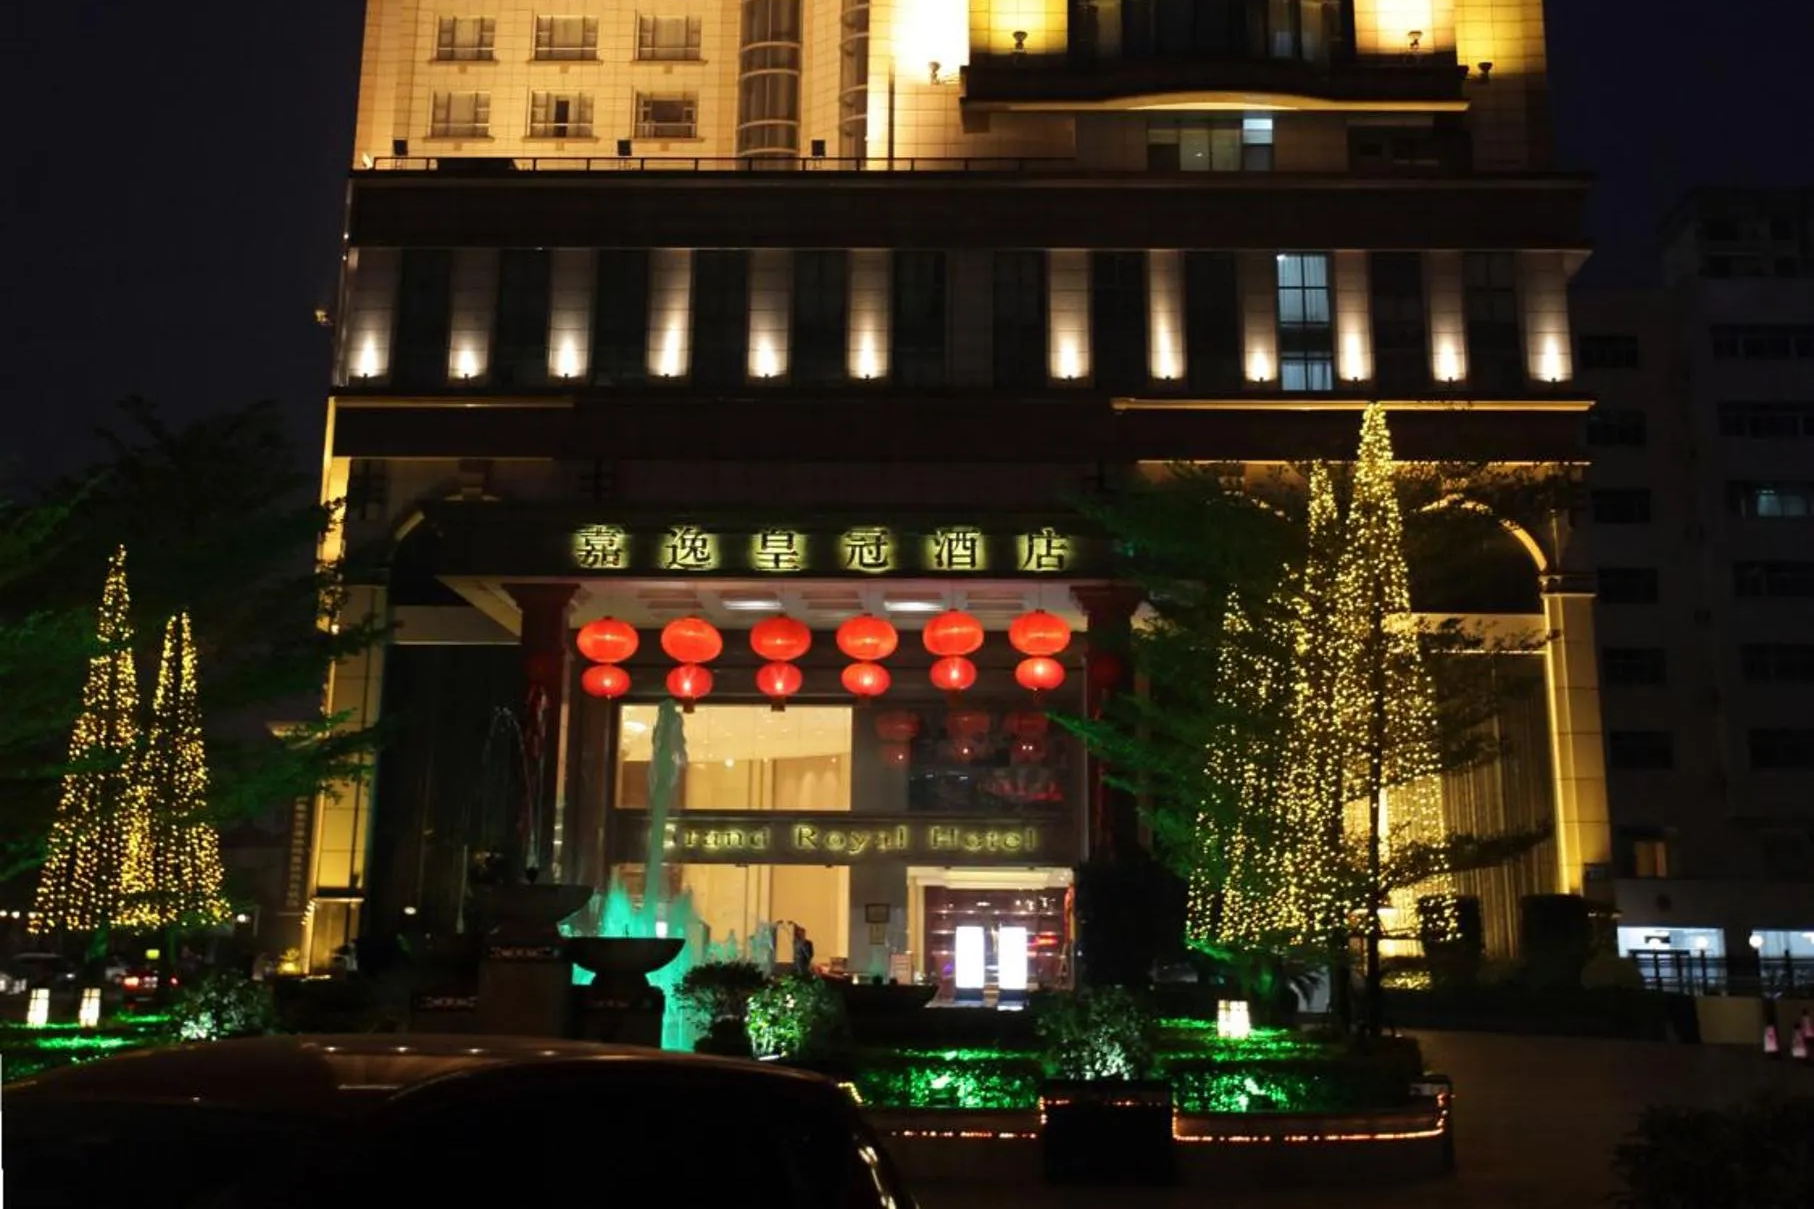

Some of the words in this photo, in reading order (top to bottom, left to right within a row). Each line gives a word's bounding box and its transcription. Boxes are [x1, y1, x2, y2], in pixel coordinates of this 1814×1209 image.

[576, 526, 1072, 571] 嘉逸皇冠酒店
[796, 824, 907, 855] Royal
[931, 825, 1037, 853] Hotel
